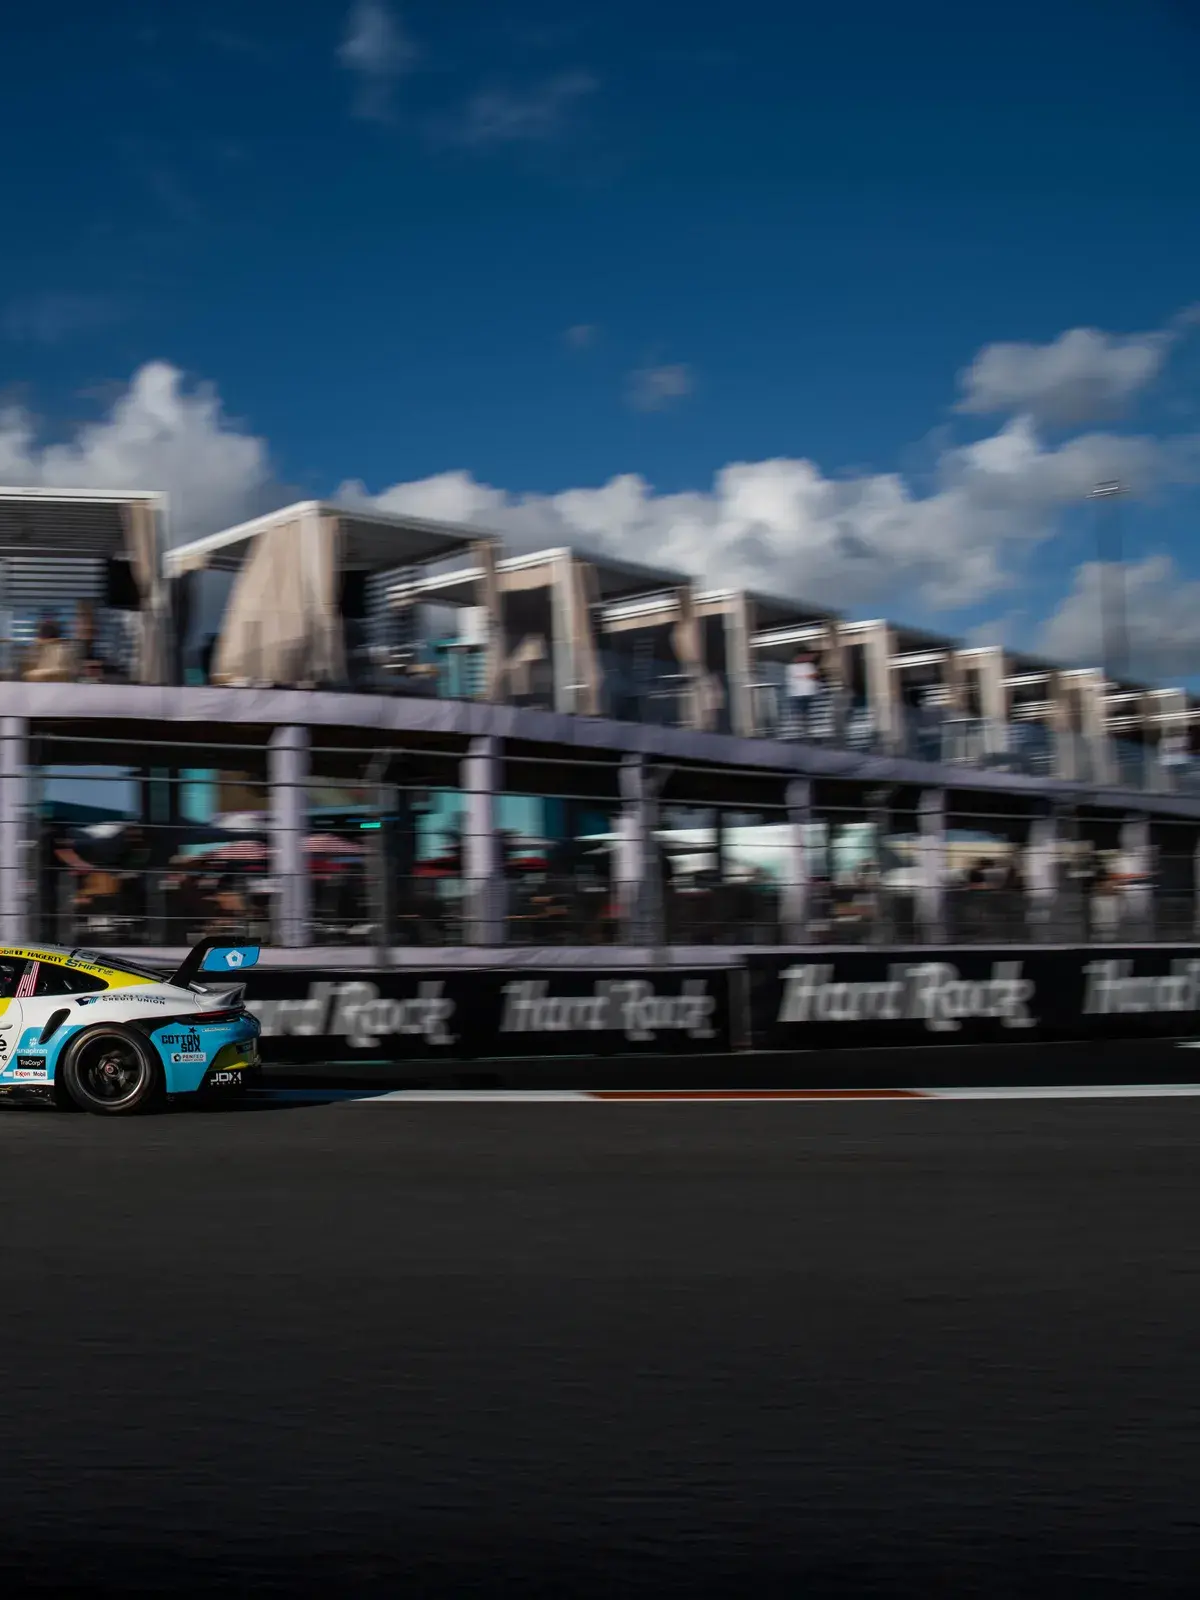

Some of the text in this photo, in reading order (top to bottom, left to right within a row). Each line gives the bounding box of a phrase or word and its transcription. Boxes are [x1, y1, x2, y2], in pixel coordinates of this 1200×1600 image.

[27, 951, 64, 963] HAGERTY
[778, 961, 1038, 1032] Hard Rock
[326, 981, 457, 1048] Rock
[161, 1034, 200, 1044] COTTON
[16, 1047, 48, 1056] snaptron
[181, 1043, 201, 1052] SOX
[210, 1071, 242, 1083] JDX
